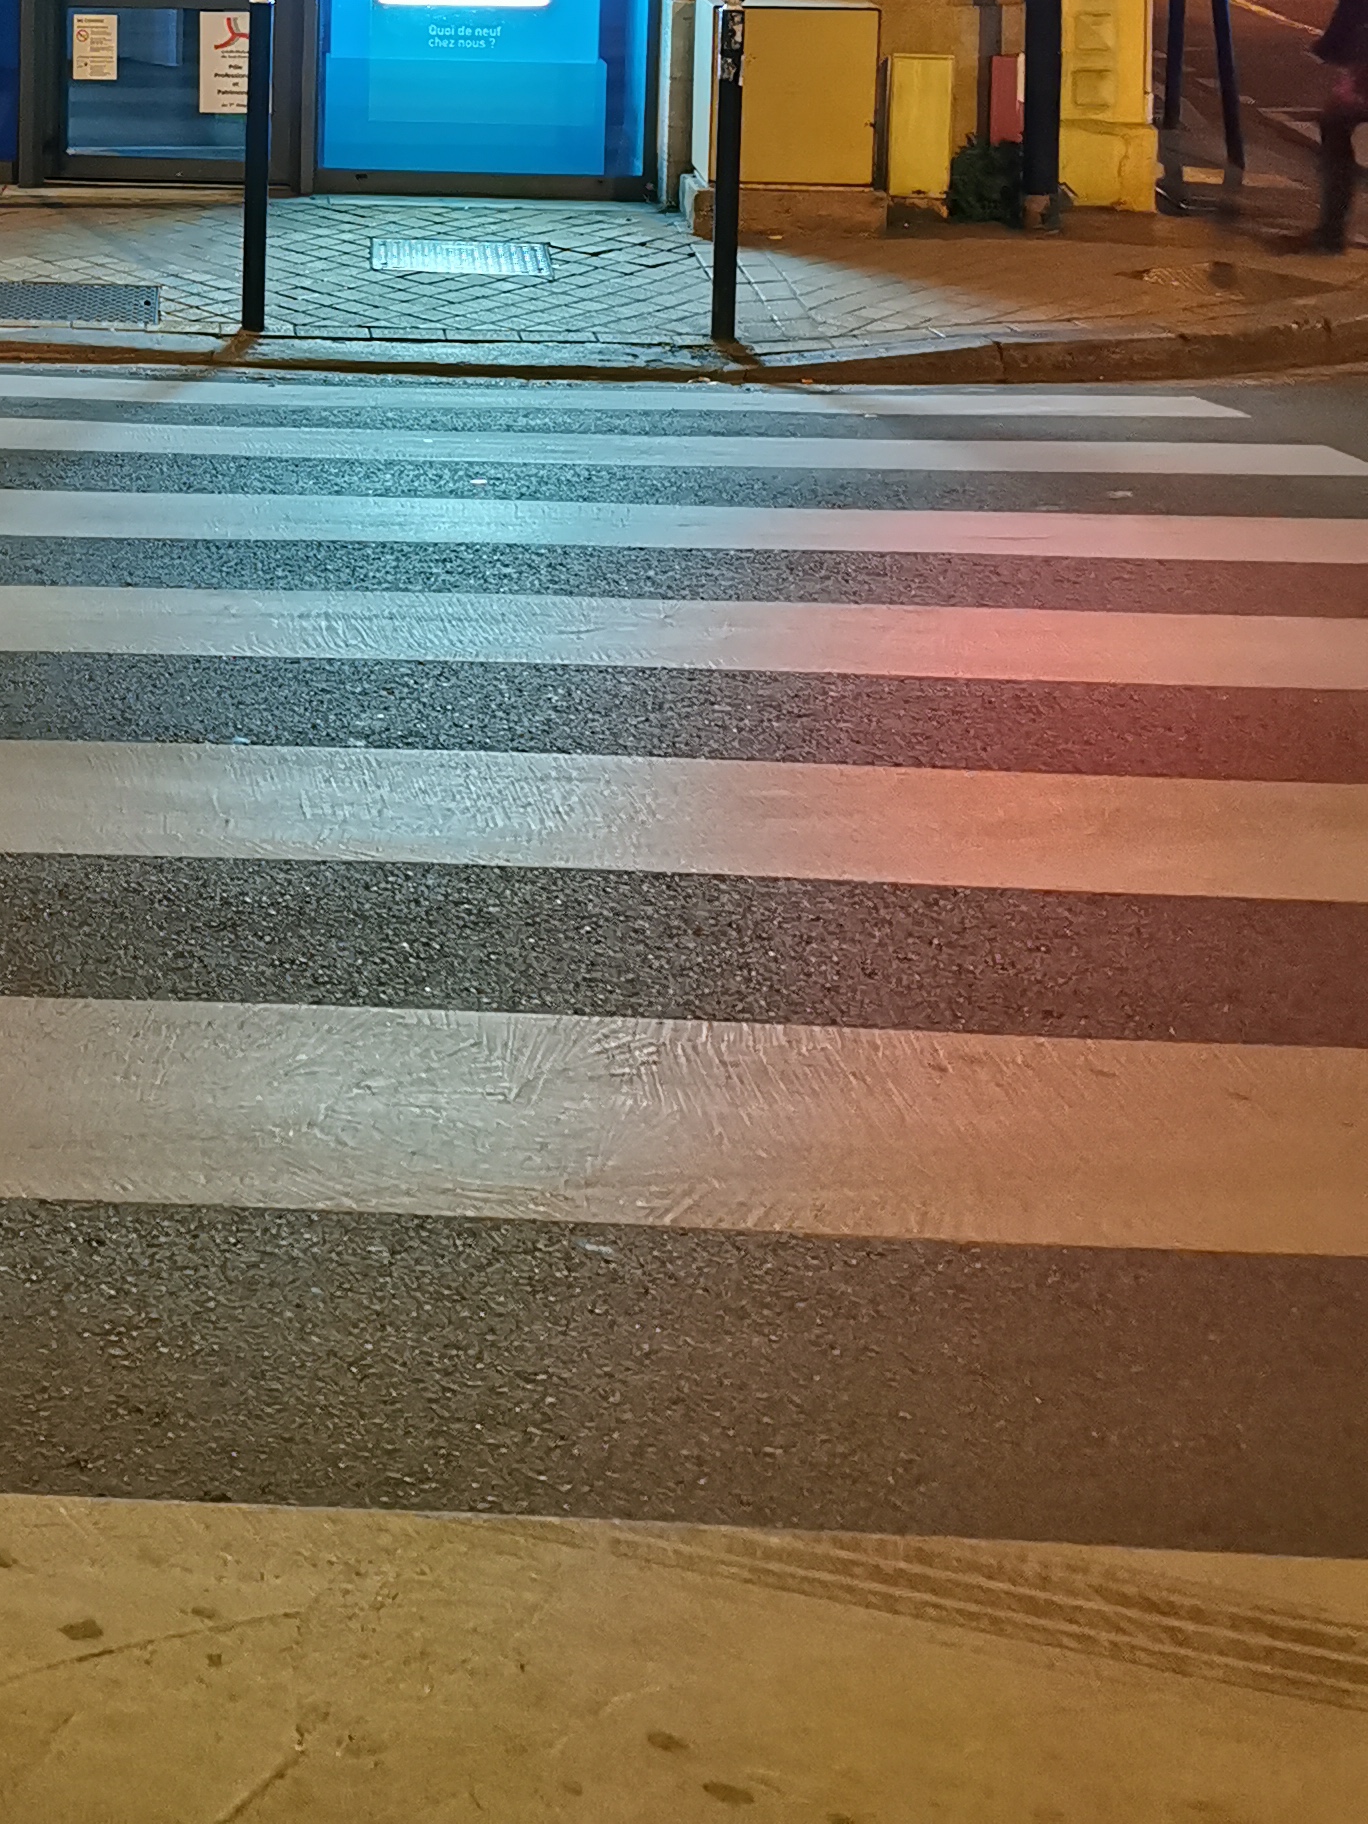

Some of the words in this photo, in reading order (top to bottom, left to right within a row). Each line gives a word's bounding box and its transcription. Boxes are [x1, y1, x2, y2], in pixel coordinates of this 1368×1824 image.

[428, 24, 455, 37] Quoi
[457, 25, 472, 37] de
[474, 26, 501, 38] neuf
[428, 37, 455, 48] chez
[457, 38, 486, 49] nous
